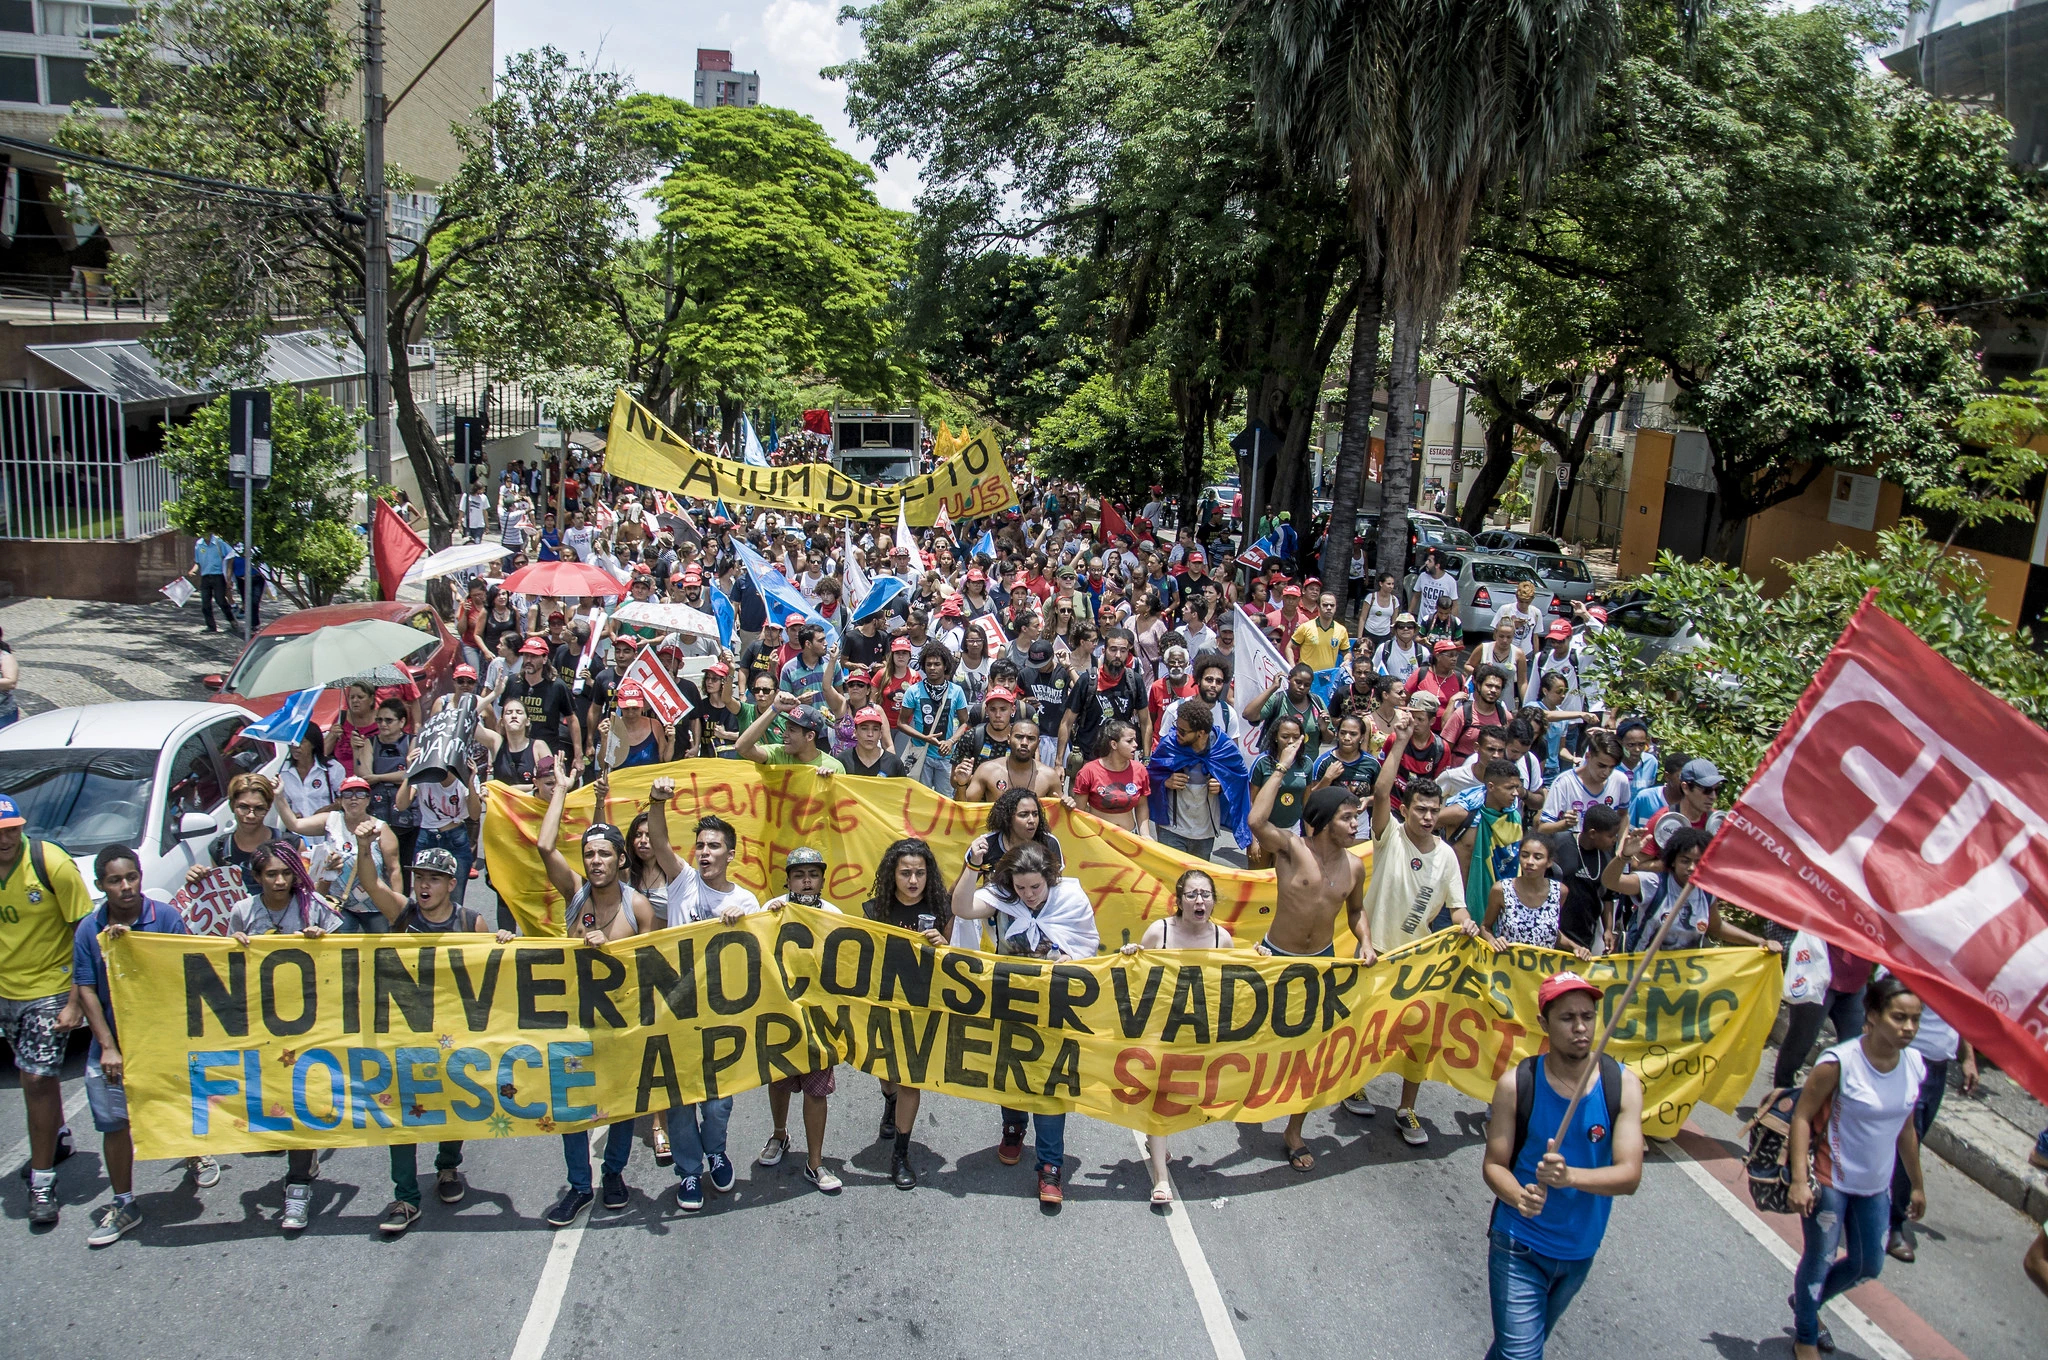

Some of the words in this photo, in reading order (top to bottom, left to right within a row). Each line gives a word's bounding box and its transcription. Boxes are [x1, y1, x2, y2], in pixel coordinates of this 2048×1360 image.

[1411, 885, 1434, 915] CALVIN
[1725, 809, 1794, 868] CENTRAL
[1798, 864, 1850, 909] ÚNICA
[1853, 911, 1887, 945] DOS
[1401, 912, 1423, 935] KLEIN
[183, 948, 317, 1037] NO
[342, 930, 762, 1034] INVERNO
[774, 921, 1359, 1044] CONSERVADOR
[1389, 954, 1515, 1020] UBES
[1588, 955, 1709, 985] ALAS
[187, 1041, 598, 1136] FLORESCE
[635, 1034, 683, 1112] A
[700, 1005, 1081, 1101] PRIMAVERA
